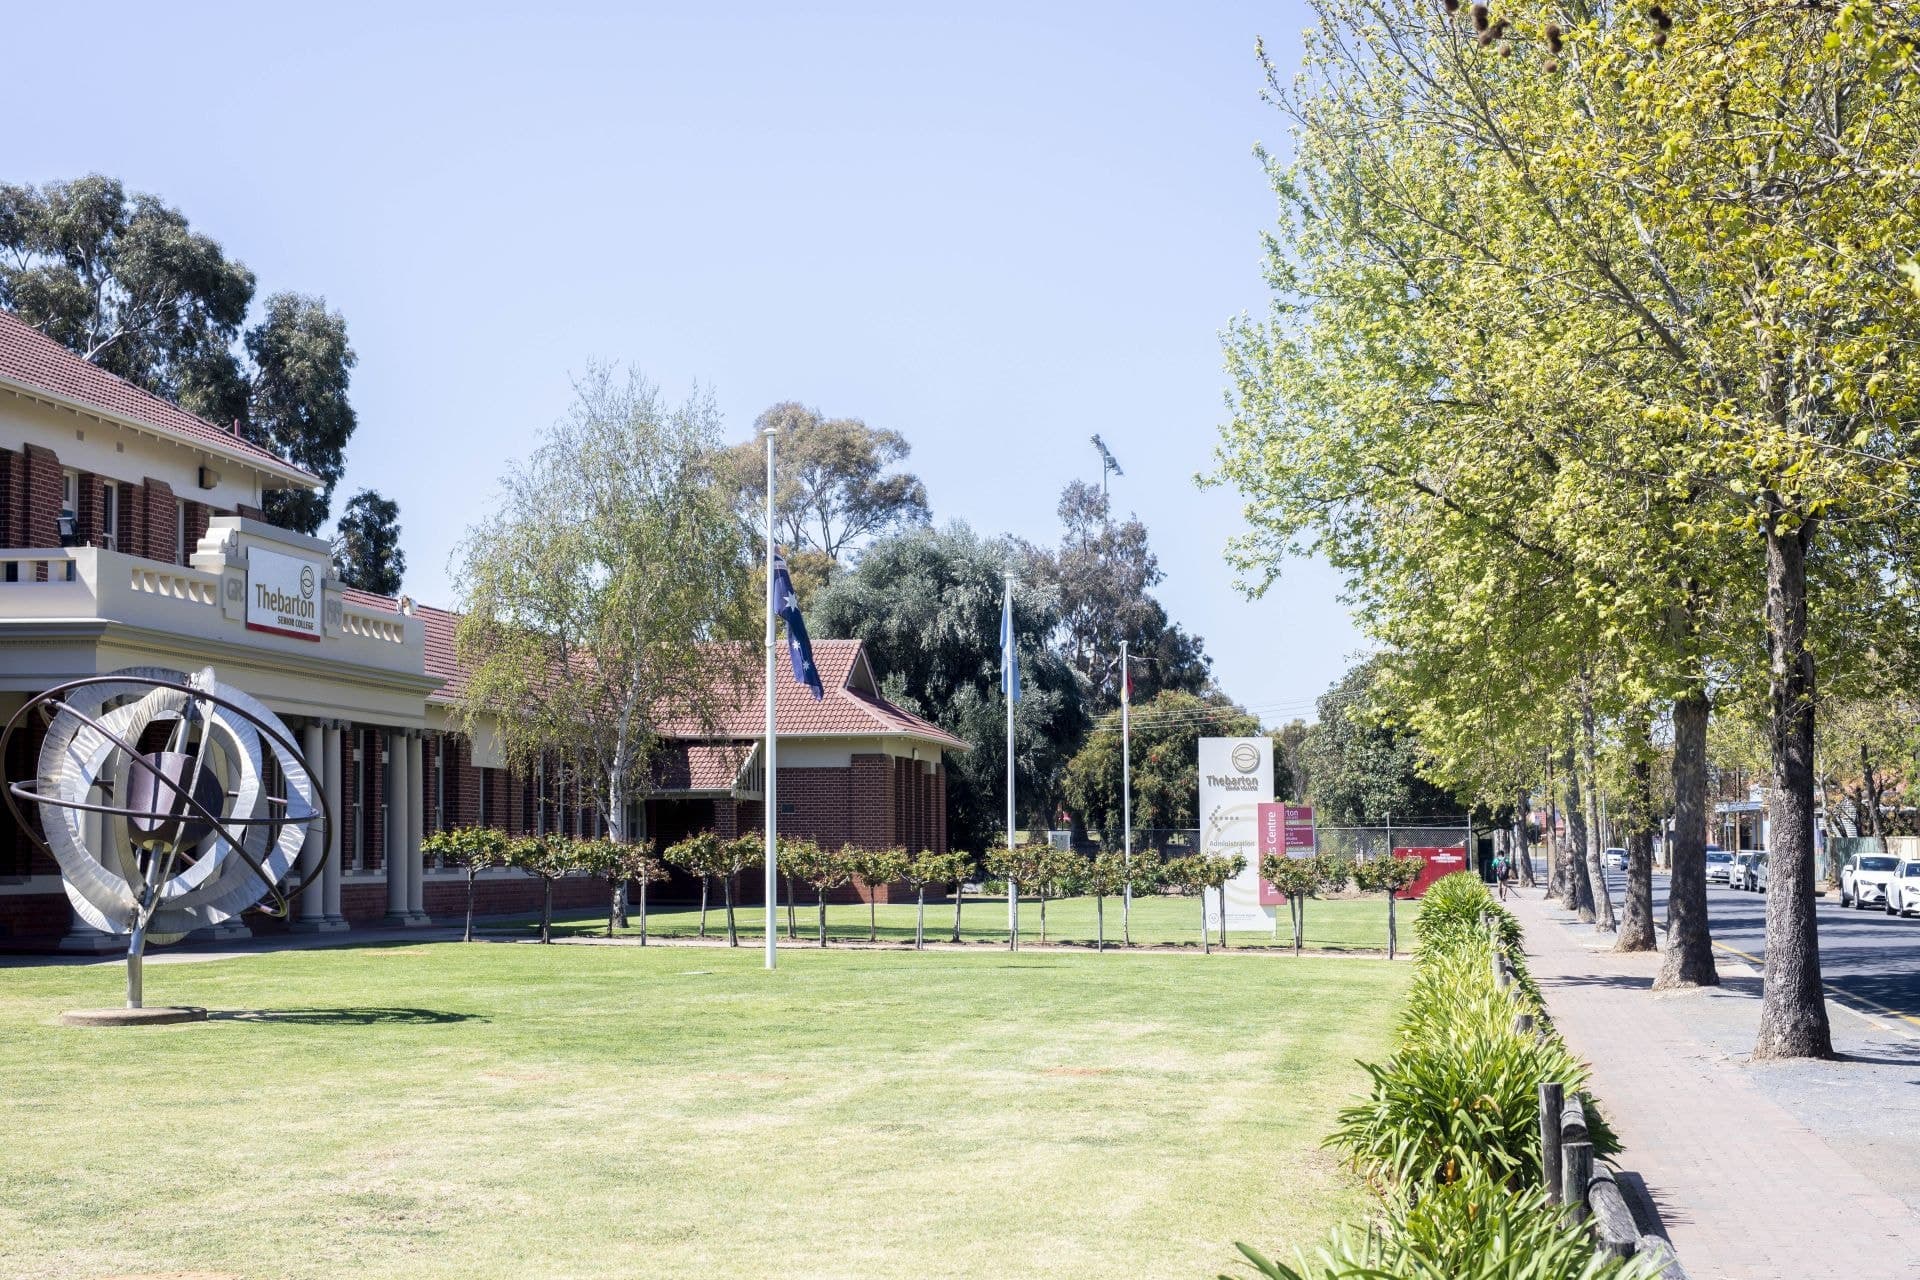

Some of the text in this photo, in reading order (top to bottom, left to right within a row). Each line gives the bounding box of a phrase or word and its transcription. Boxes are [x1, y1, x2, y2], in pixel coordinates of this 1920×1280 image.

[255, 583, 315, 618] Thebarton
[277, 616, 314, 631] SENIOR COLLEGE
[1206, 774, 1259, 787] Thebarton
[1266, 810, 1277, 844] Centre
